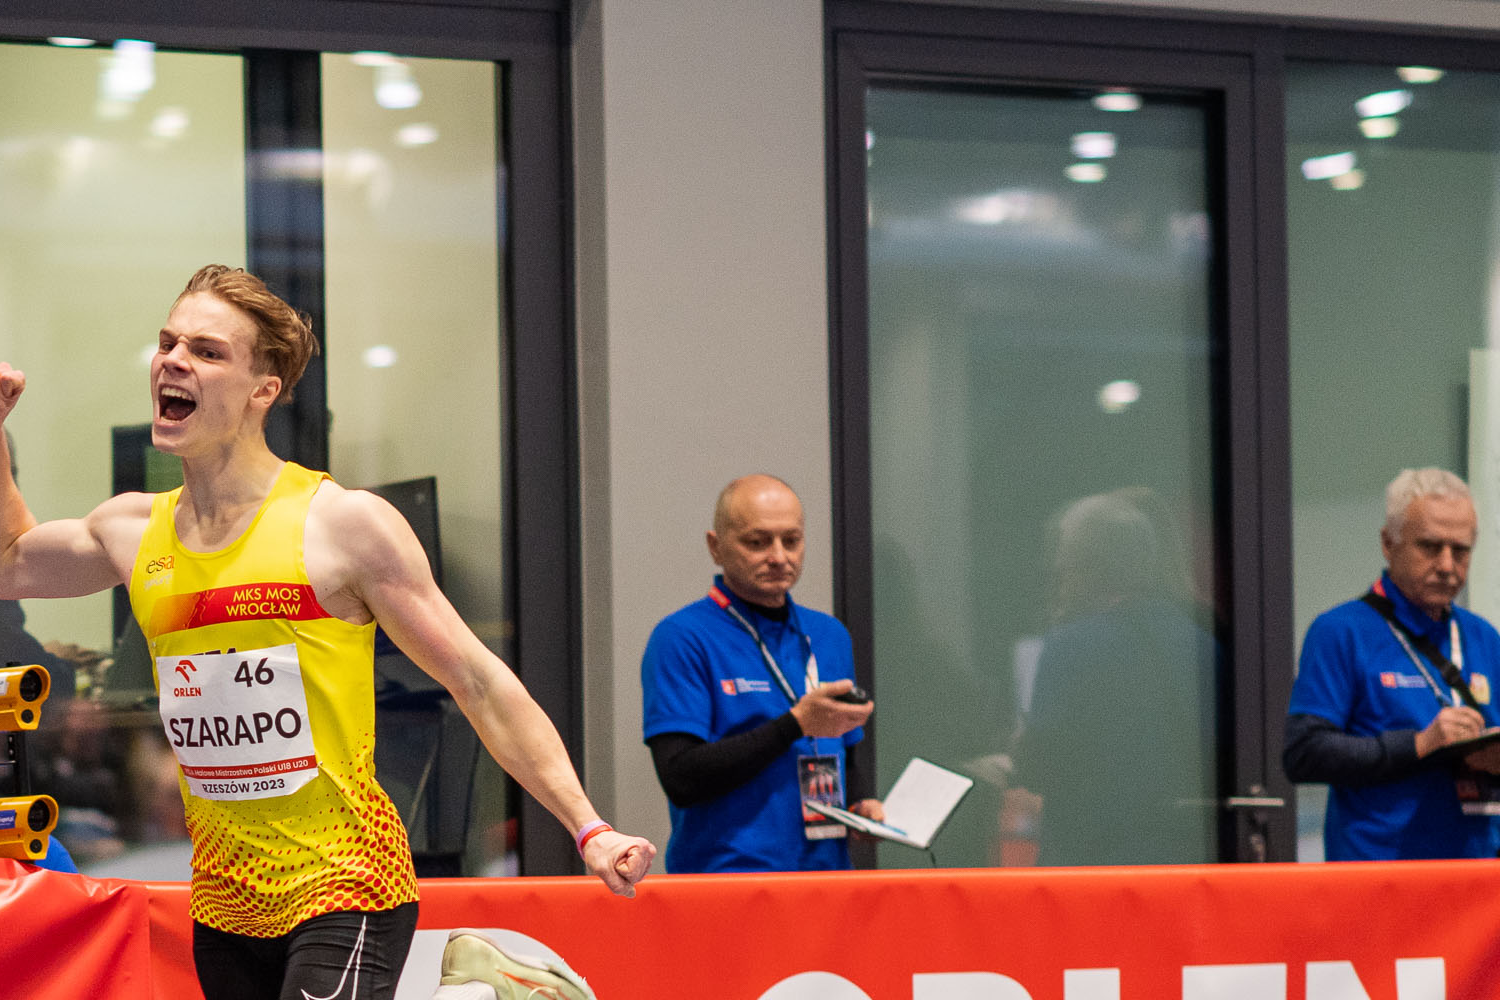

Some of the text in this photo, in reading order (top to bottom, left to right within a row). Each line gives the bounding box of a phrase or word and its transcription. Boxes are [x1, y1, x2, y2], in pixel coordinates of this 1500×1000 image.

[233, 587, 301, 603] MKS MOS
[225, 602, 301, 617] WROCŁAW
[234, 657, 275, 688] 46
[173, 687, 202, 698] ORLEN
[168, 707, 301, 748] SZARAPO
[215, 768, 253, 777] Mistrzostwa
[254, 764, 277, 774] Polski
[277, 762, 292, 771] U18
[292, 759, 309, 769] U20
[202, 778, 285, 794] RZESZÓW 2023
